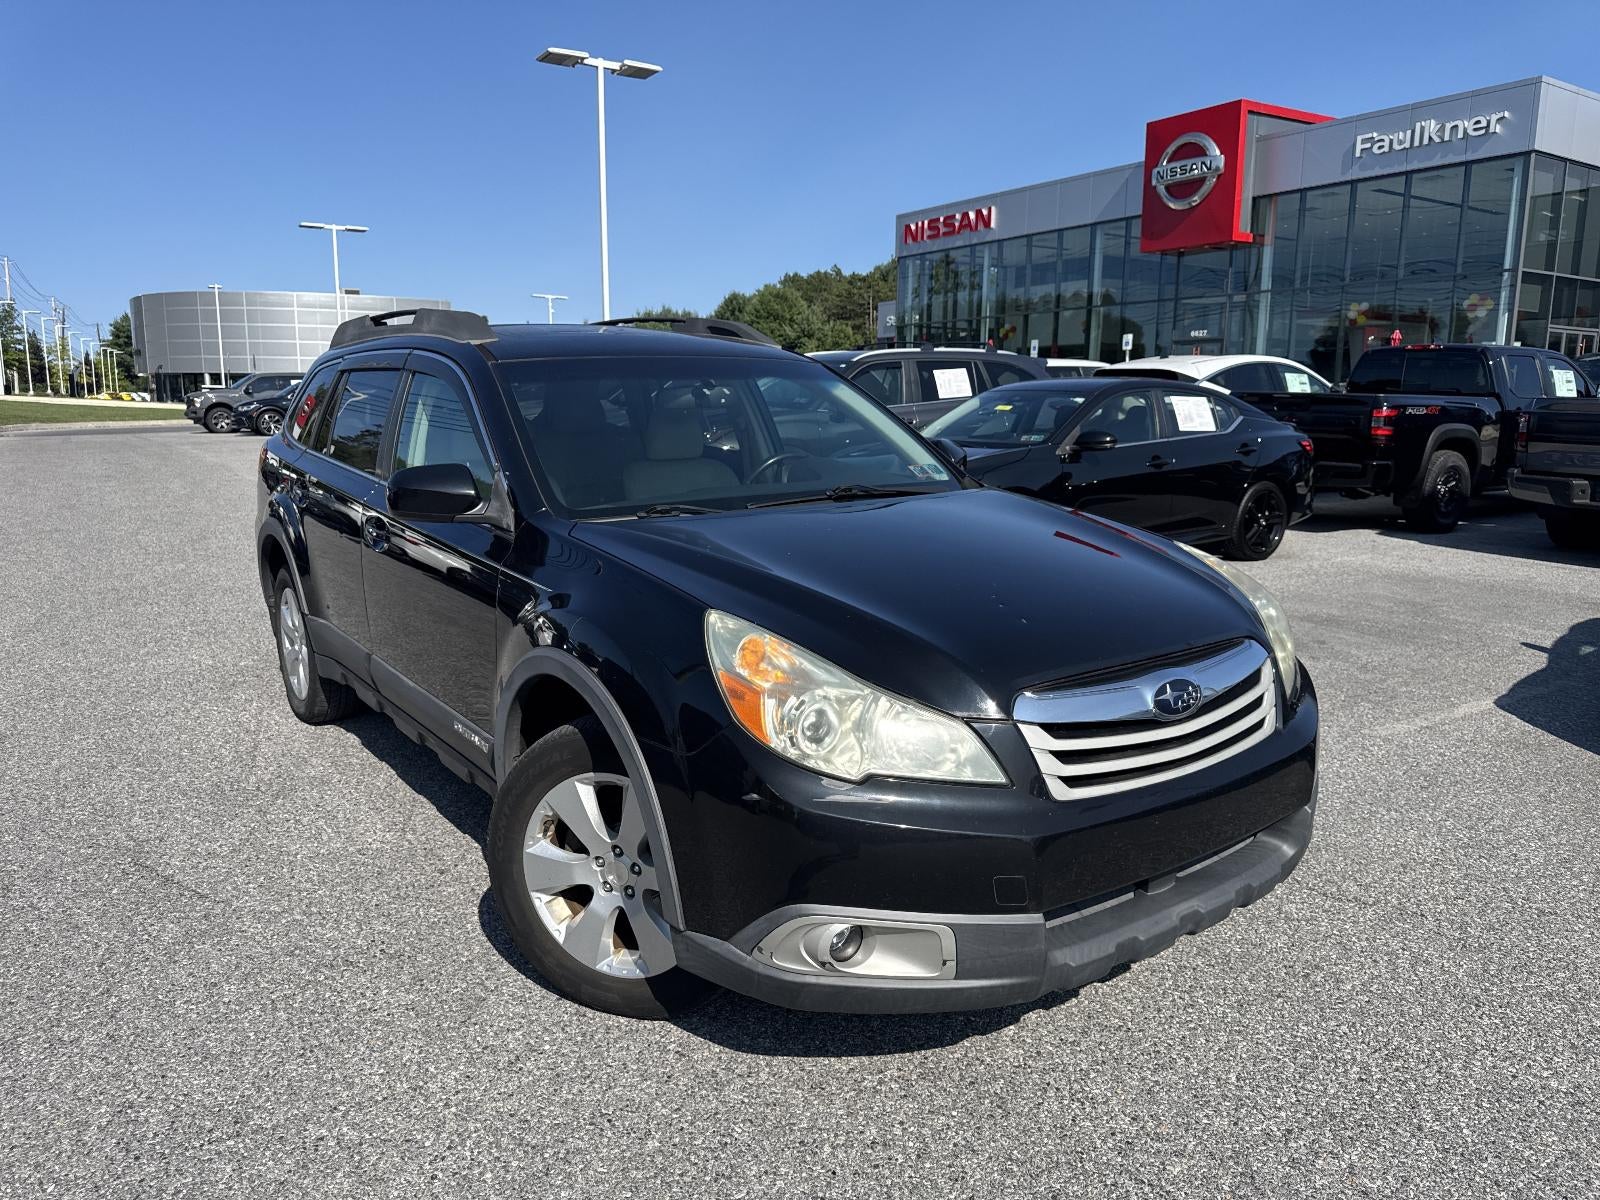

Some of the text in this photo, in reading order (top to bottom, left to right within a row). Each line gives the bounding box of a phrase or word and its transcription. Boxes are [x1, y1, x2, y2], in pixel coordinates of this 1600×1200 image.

[1354, 110, 1509, 158] Faulkner
[1155, 160, 1213, 183] NISSAN
[904, 206, 994, 244] NISSAN
